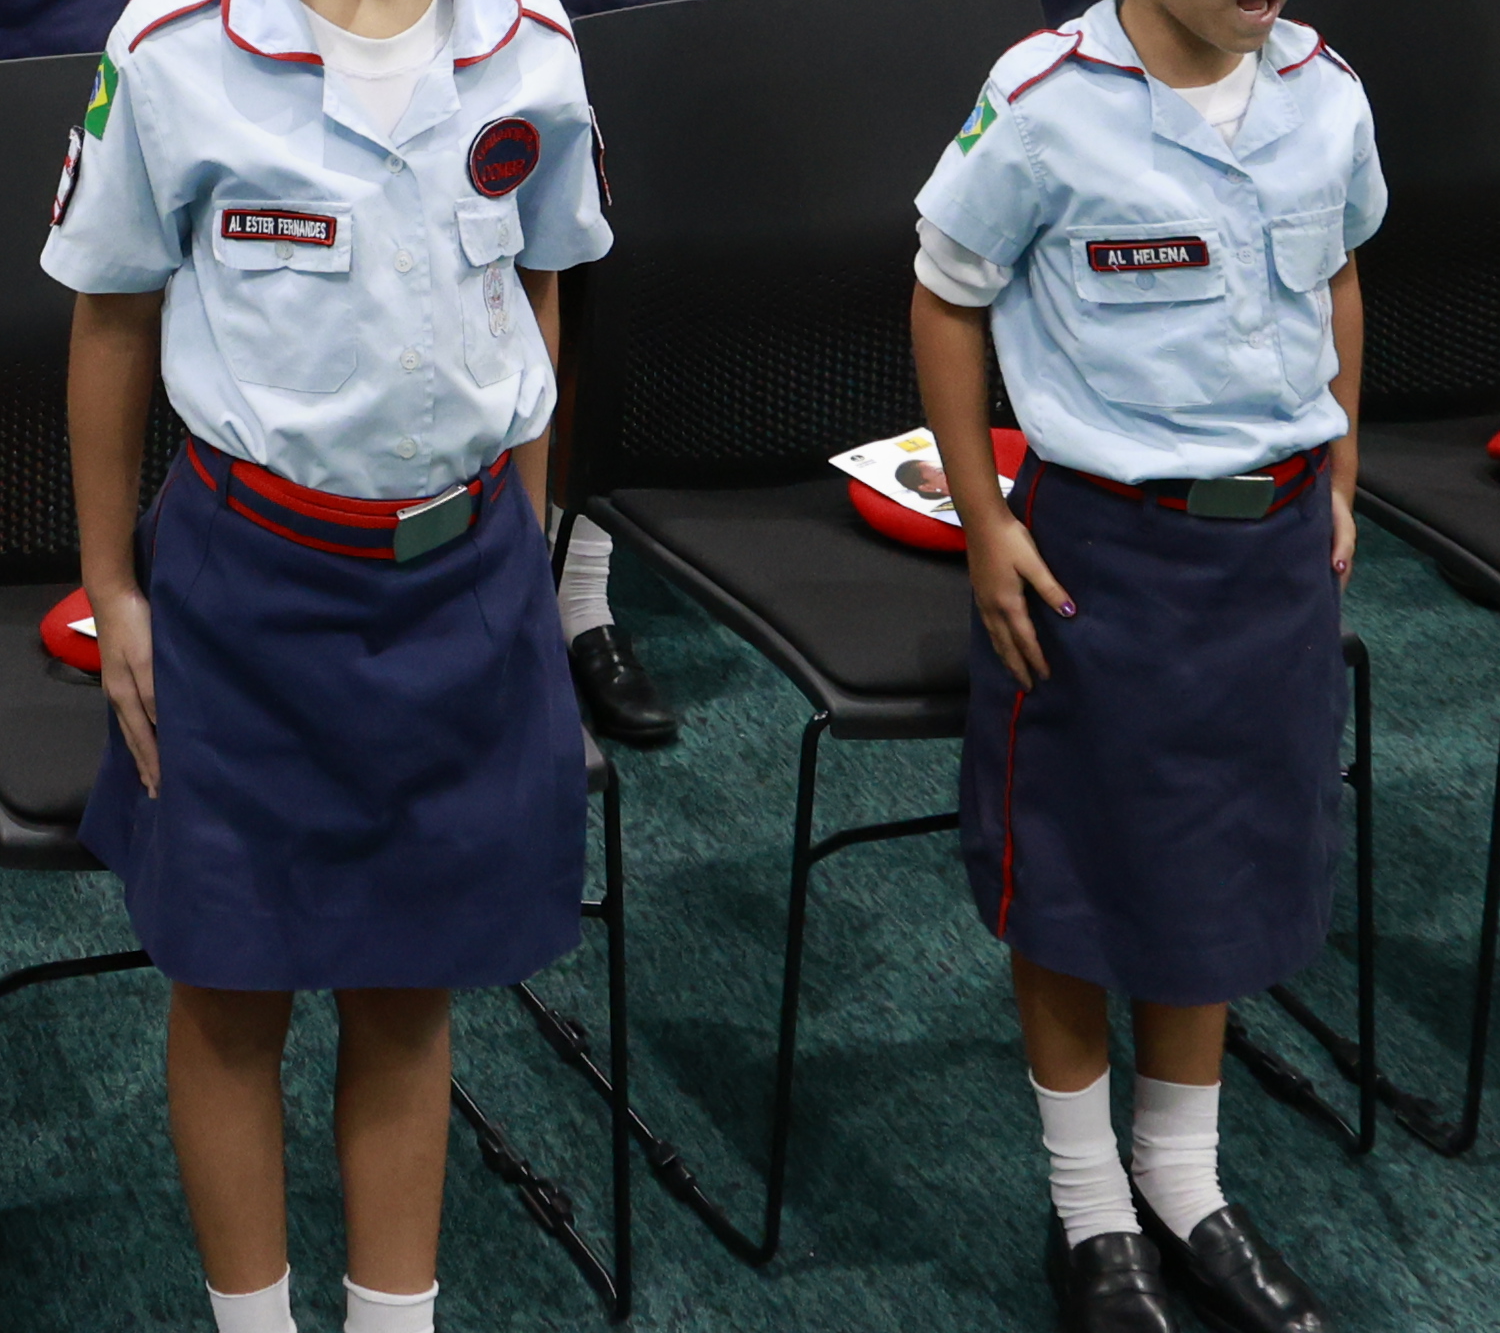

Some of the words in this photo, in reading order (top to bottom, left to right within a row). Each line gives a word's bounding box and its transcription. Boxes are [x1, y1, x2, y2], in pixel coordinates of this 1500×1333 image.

[229, 215, 242, 235] AL
[246, 216, 275, 237] ESTER
[278, 218, 327, 240] FERNANDES
[1108, 249, 1126, 266] AL
[1133, 244, 1190, 265] HELENA
